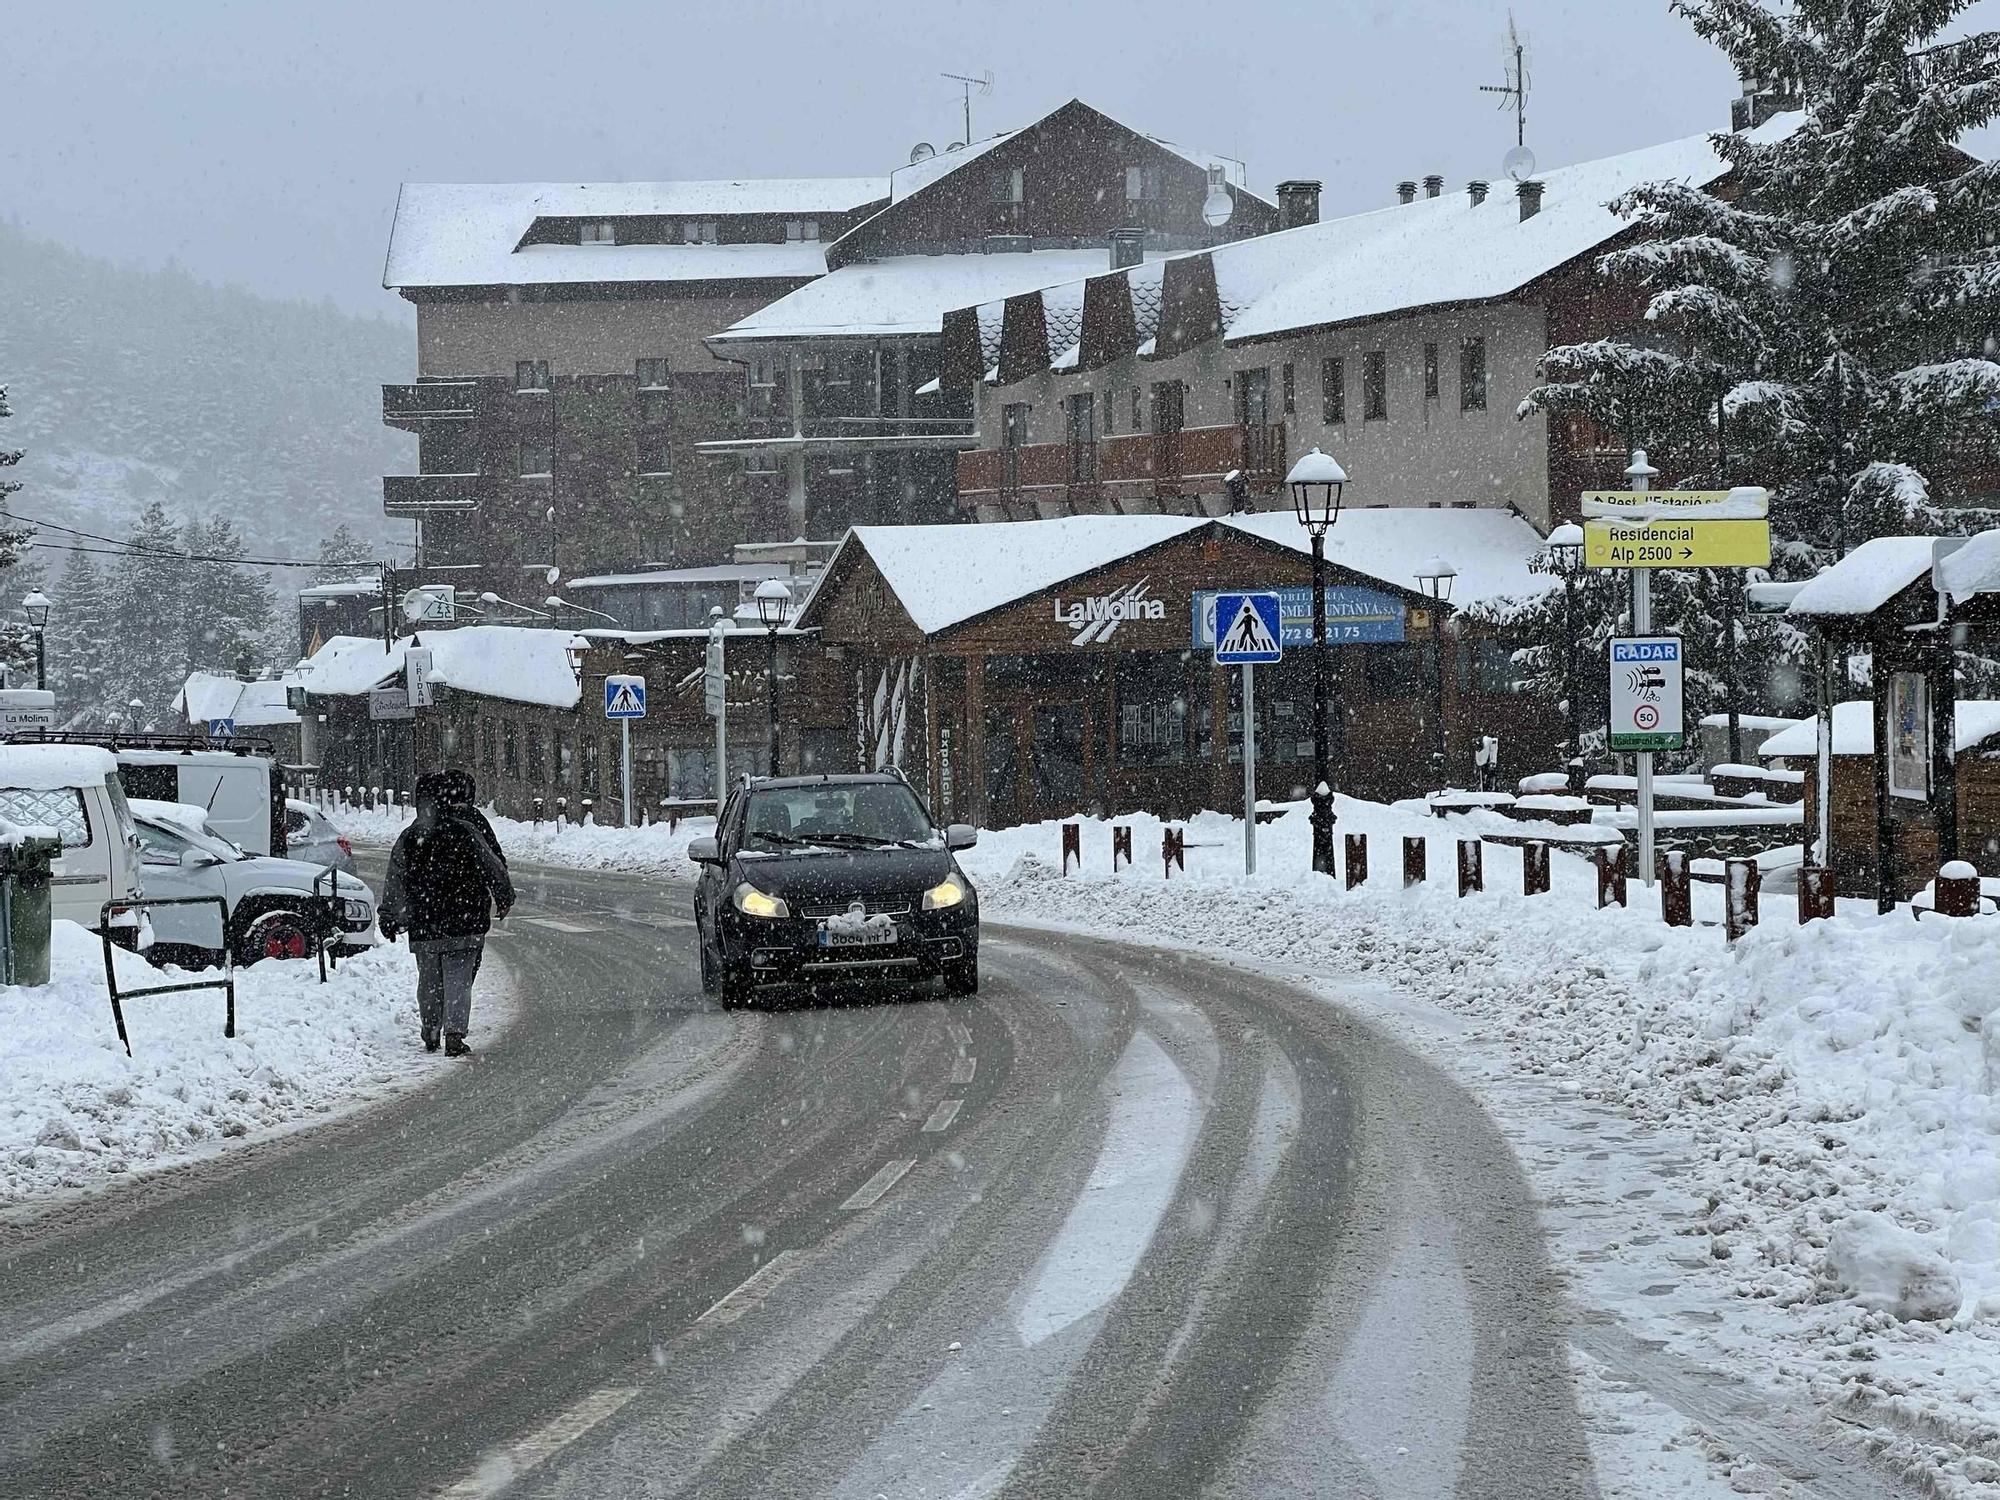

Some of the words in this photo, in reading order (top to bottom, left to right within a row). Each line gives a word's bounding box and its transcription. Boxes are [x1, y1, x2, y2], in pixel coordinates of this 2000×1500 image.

[1610, 526, 1694, 541] Residencial
[1610, 546, 1635, 564] Alp
[1638, 546, 1672, 561] 2500
[1280, 603, 1306, 618] SME
[1344, 626, 1360, 638] 75
[1616, 645, 1675, 660] RADAR
[5, 714, 17, 723] La
[19, 714, 49, 723] Molina
[1639, 713, 1654, 722] 50
